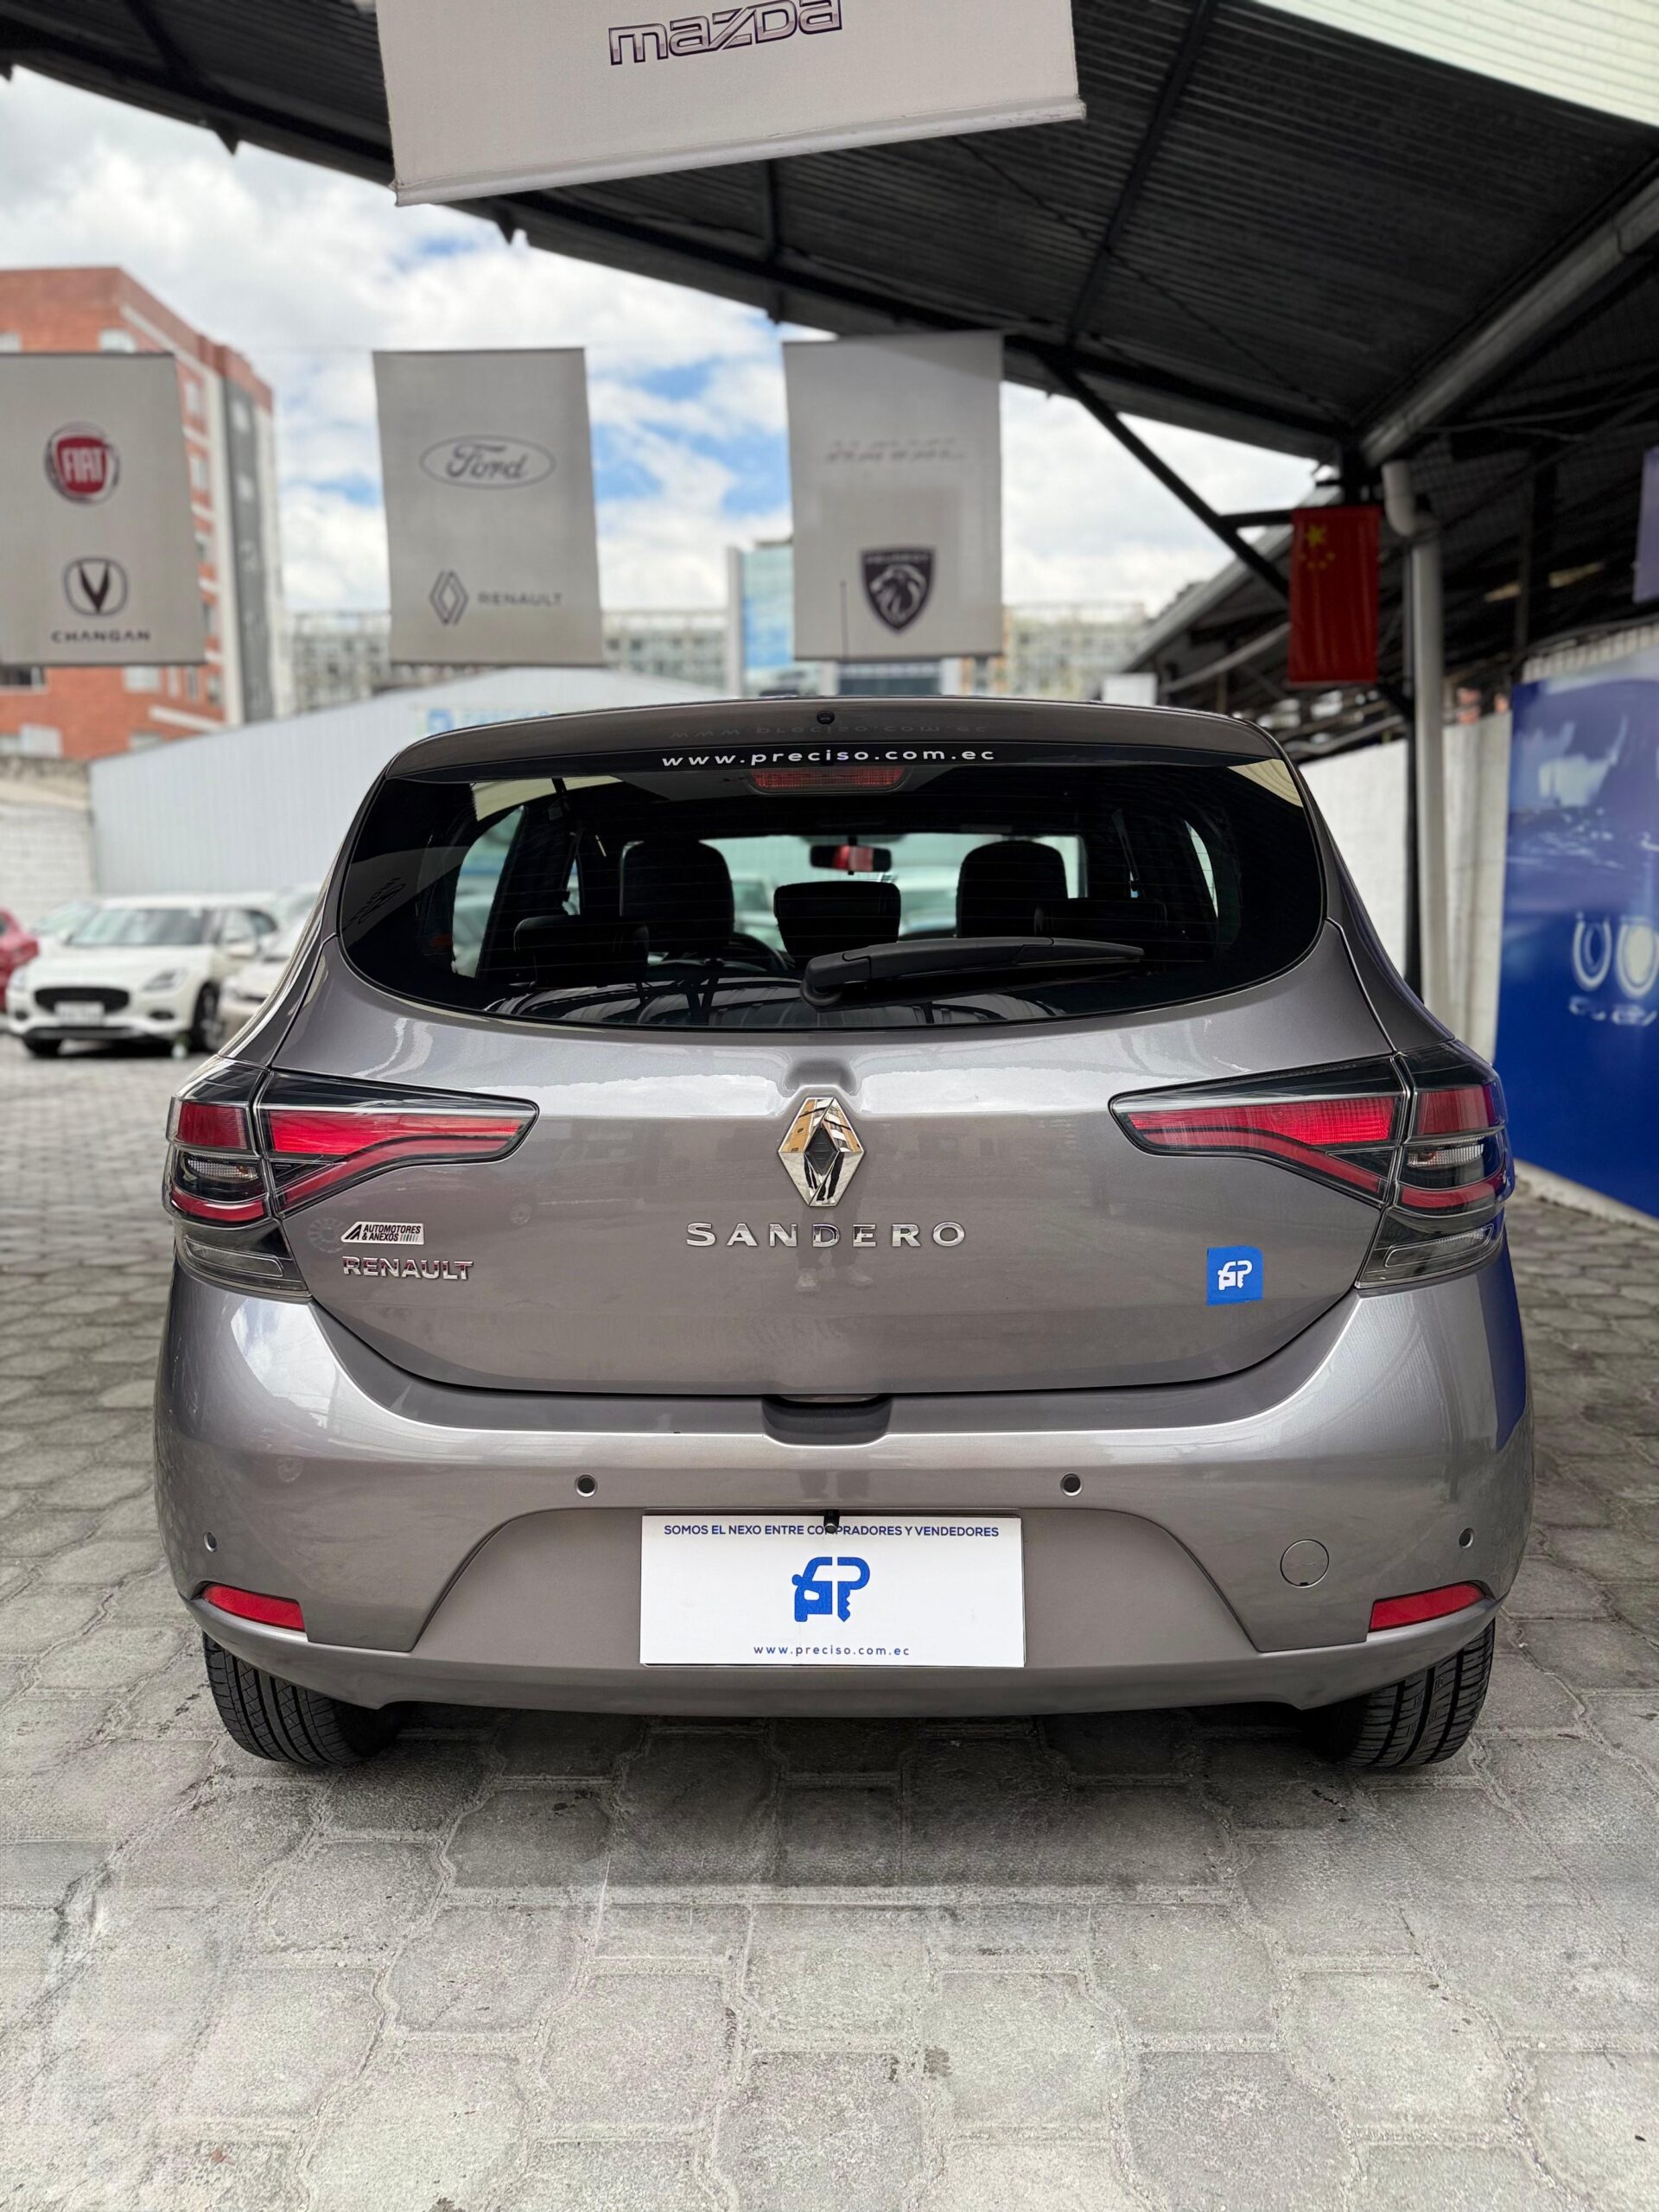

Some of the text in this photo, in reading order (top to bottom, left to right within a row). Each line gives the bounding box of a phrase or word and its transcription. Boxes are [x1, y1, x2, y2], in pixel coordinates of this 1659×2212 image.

[608, 0, 842, 66] mazda
[60, 447, 105, 482] FIAT
[446, 442, 529, 478] Ford
[478, 592, 562, 607] RENAULT
[51, 630, 150, 644] CHANGAN
[662, 750, 995, 766] www.preciso.com.ec
[363, 1224, 422, 1234] AUTOMOTORES
[686, 1222, 965, 1247] SANDERO
[369, 1233, 399, 1242] ANEXOS
[342, 1255, 474, 1281] RENAULT
[664, 1525, 1000, 1537] SOMOS EL NEXO ENTRE COPRADORES Y VENDEDORES
[753, 1644, 910, 1657] www.preciso.com.ec
